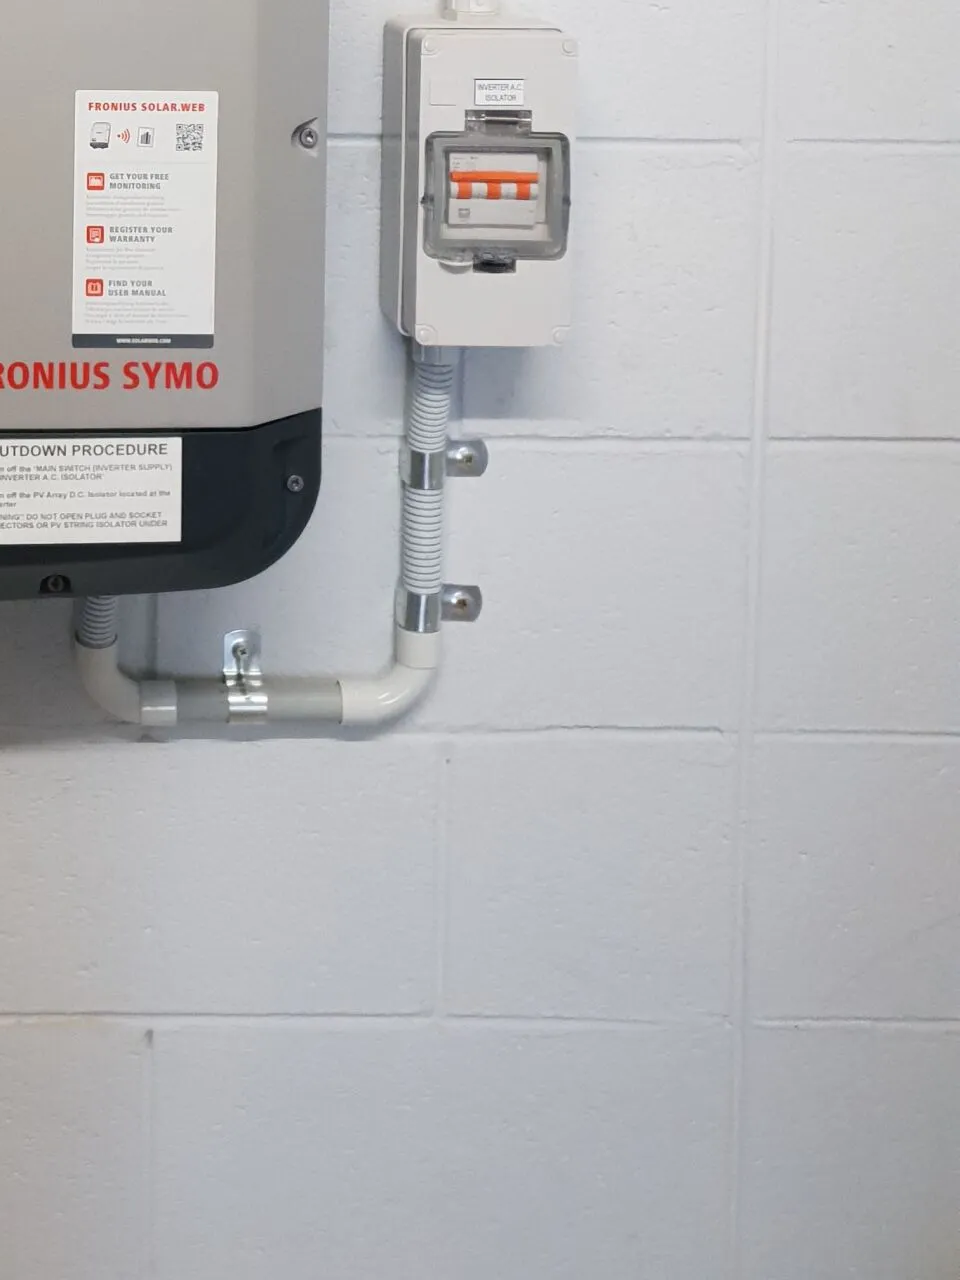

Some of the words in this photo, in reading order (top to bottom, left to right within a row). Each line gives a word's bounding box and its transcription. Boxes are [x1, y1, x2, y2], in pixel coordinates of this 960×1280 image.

[485, 94, 517, 102] ISOLATOR
[88, 102, 137, 112] FRONIUS
[141, 102, 205, 112] SOLAR.WEB
[109, 182, 161, 190] MONITORING
[109, 235, 155, 243] WARRANTY
[122, 361, 220, 390] SYMO
[72, 444, 168, 456] PROCEDURE
[59, 464, 90, 472] SWITCH
[46, 491, 68, 499] Array
[96, 520, 137, 528] ISOLATOR
